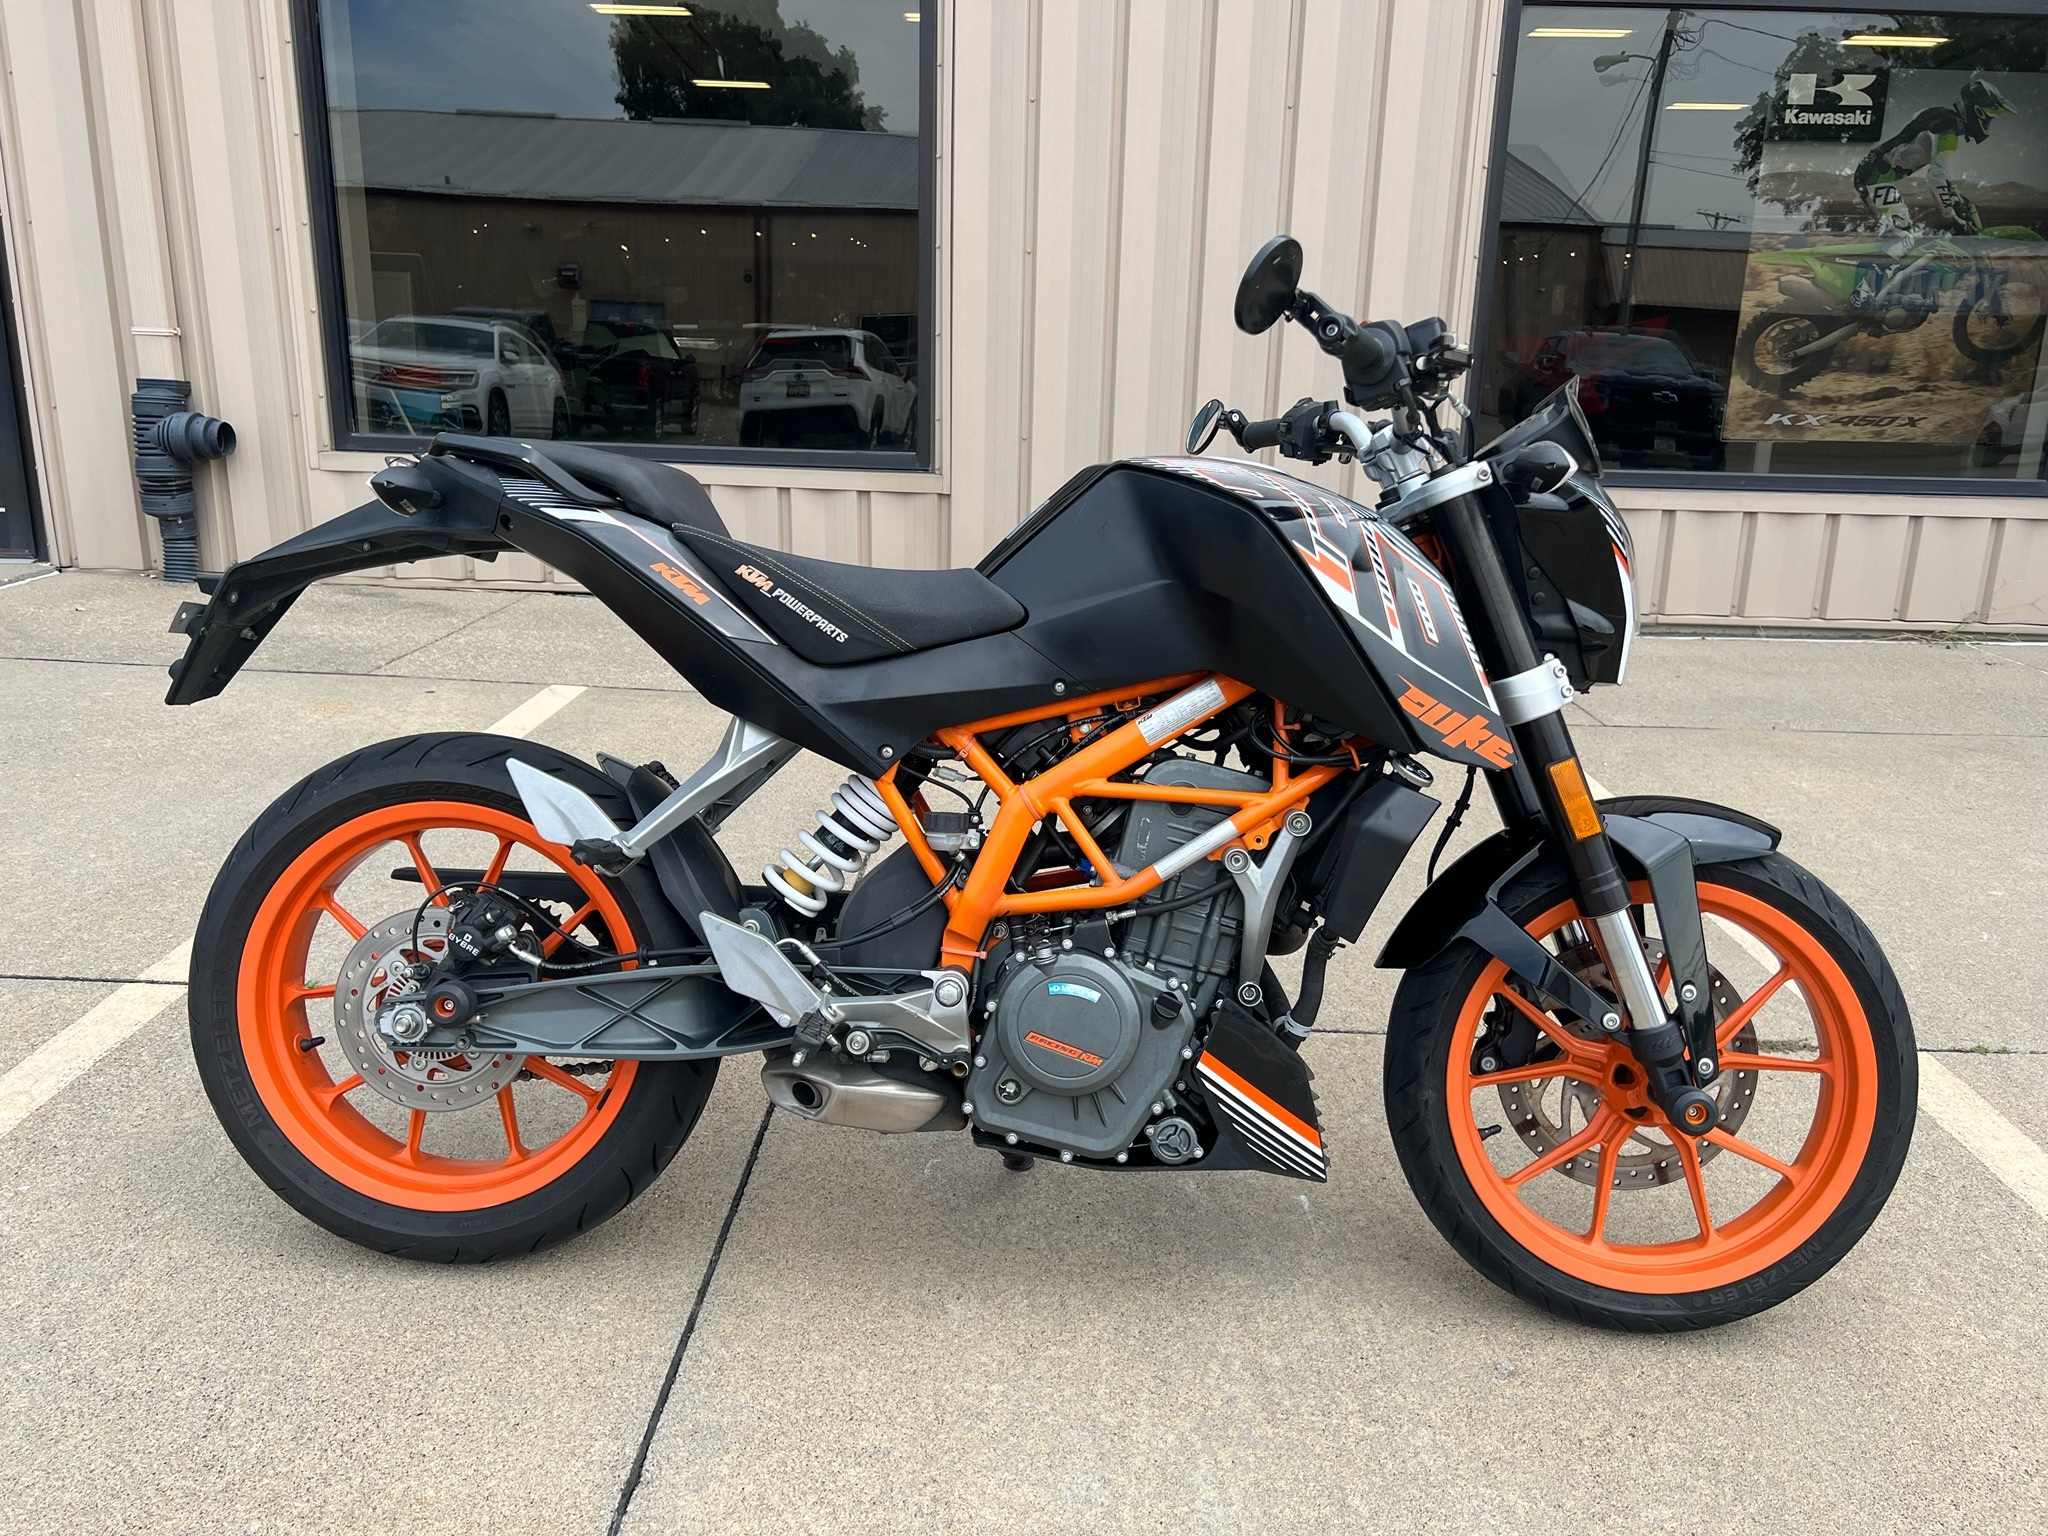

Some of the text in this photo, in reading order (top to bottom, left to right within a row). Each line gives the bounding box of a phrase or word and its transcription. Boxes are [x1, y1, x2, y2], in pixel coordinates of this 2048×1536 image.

[1784, 108, 1872, 125] Kawasaki
[650, 561, 710, 606] KTM
[734, 564, 849, 644] KTM POWERPARTS
[1137, 713, 1154, 726] KTM
[1397, 673, 1515, 770] DUKE
[448, 932, 480, 957] BYBRE
[211, 984, 263, 1128] METZELER
[1030, 1034, 1104, 1067] RACING KTM
[1707, 1240, 1825, 1305] METZELER
